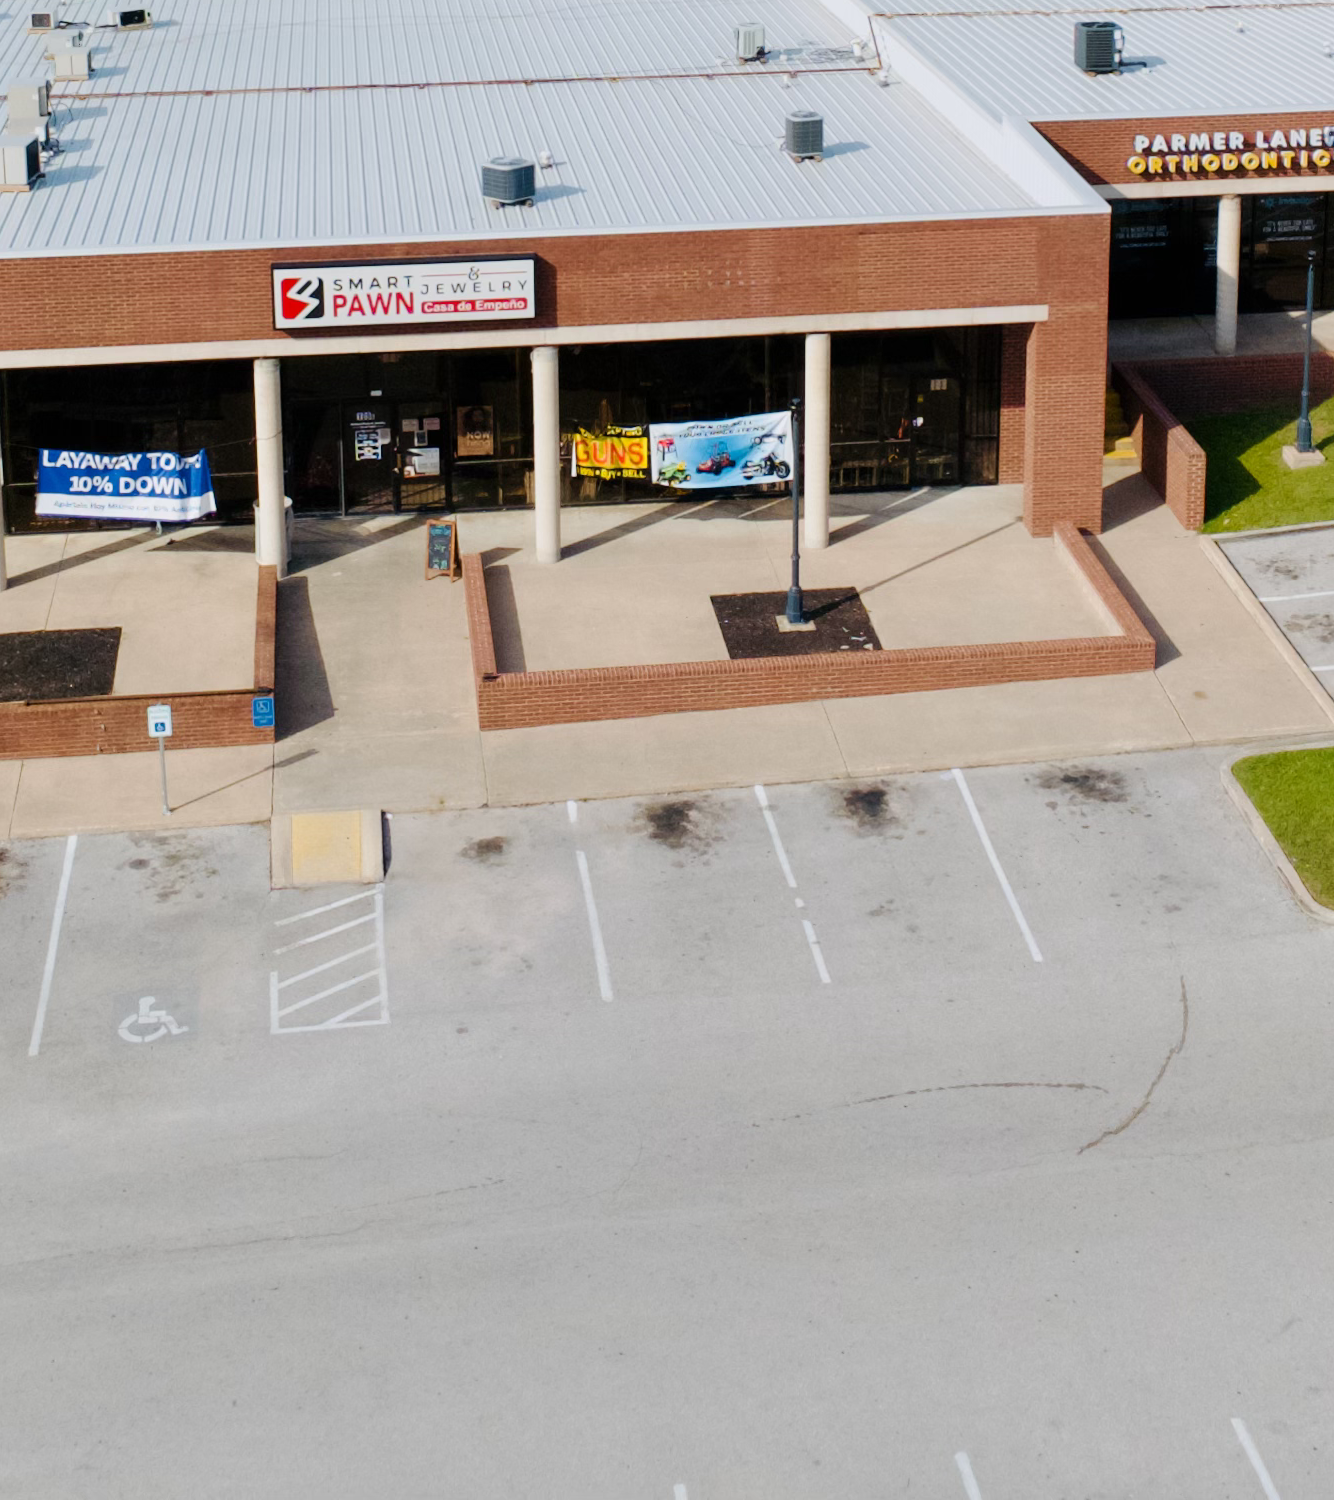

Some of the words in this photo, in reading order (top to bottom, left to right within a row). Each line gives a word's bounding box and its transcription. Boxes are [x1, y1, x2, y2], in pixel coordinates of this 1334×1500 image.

[1134, 131, 1245, 153] PARMER
[1255, 128, 1323, 148] LANE
[468, 266, 480, 281] &
[333, 275, 414, 292] SMART
[421, 280, 527, 295] JEWELRY
[333, 292, 414, 318] PAWN
[424, 301, 455, 313] Casa
[457, 300, 472, 312] de
[475, 298, 526, 312] Empeño
[42, 450, 142, 471] LAYAWAY
[575, 439, 644, 465] GUNS
[622, 469, 647, 479] SELL
[69, 475, 114, 493] 10%
[119, 476, 188, 495] DOWN
